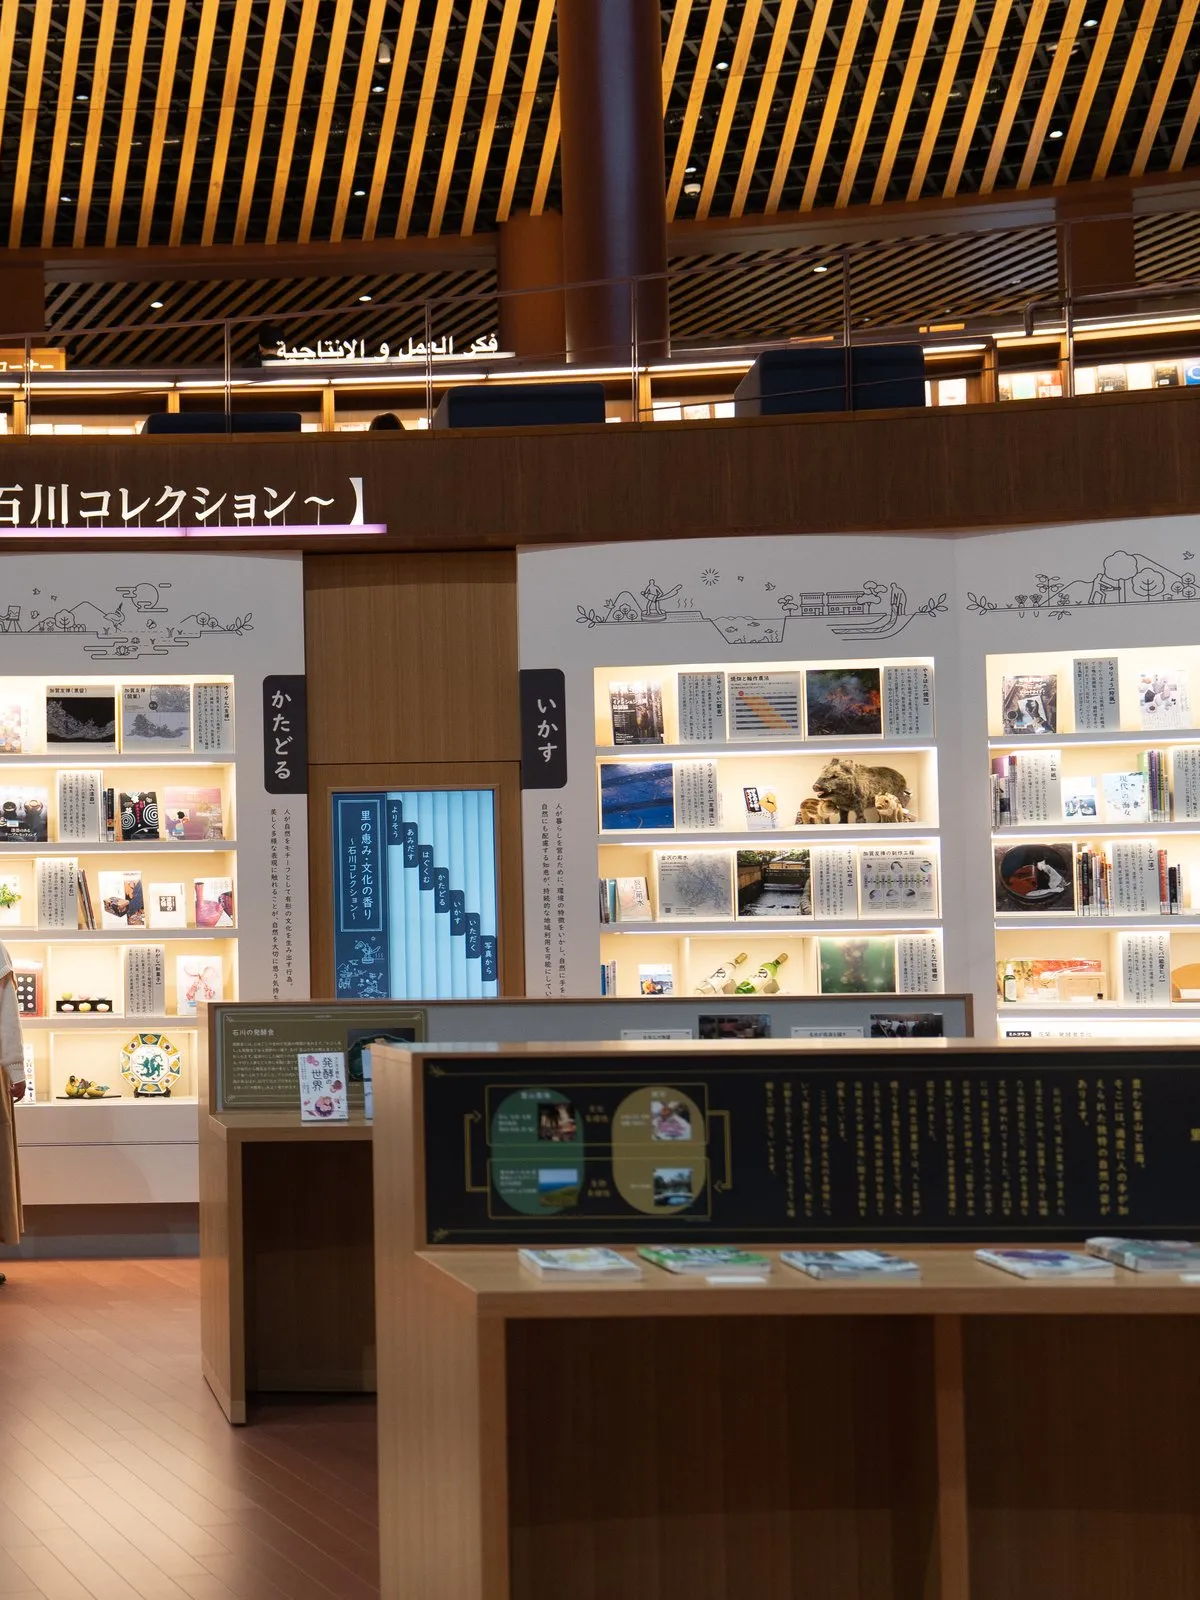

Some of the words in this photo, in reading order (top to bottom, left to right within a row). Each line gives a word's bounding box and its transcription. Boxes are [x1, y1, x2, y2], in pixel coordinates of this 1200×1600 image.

[271, 690, 292, 781] かたどる
[537, 697, 559, 763] いかす
[391, 806, 399, 838] よりそう
[406, 828, 415, 861] あみだす
[348, 837, 359, 920] ～石川コレクション～
[360, 810, 373, 920] 里の恵み・文化の香り
[422, 851, 430, 884] はぐくむ
[284, 808, 293, 986] 人が自然をモチーフとして有形の文化を生み出す行為。
[437, 874, 446, 906] かたどる
[453, 901, 461, 925] いかす
[469, 920, 477, 951] いただく
[484, 942, 492, 974] 写真から
[232, 1028, 275, 1037] 石川の発酵食
[311, 1068, 324, 1092] 世界
[321, 1057, 335, 1085] 発酵の
[1077, 1079, 1090, 1126] あります。
[1132, 1078, 1146, 1168] 豊かな里山と里海。
